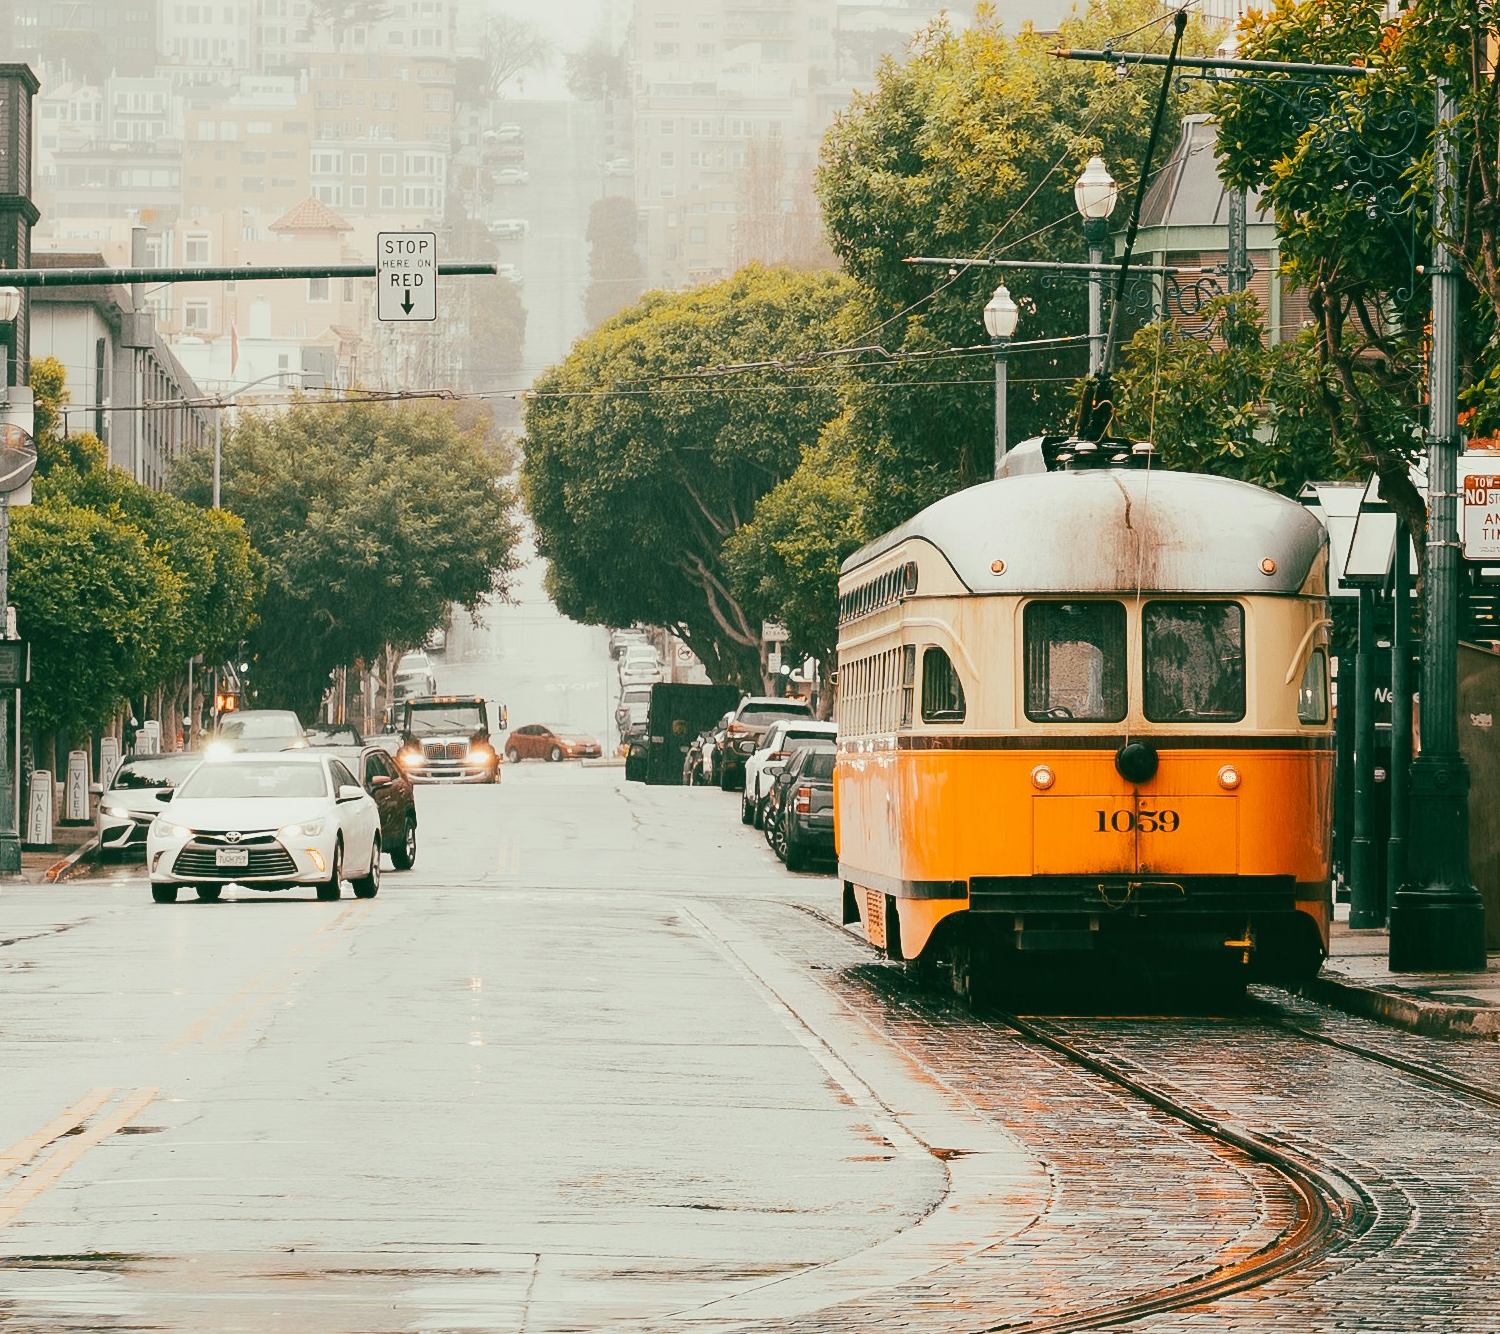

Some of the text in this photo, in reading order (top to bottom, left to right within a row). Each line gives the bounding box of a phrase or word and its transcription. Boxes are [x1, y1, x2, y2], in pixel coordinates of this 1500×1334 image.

[385, 240, 429, 254] STOP
[382, 259, 431, 268] HERE ON
[391, 273, 423, 287] RED
[1465, 488, 1486, 505] NO
[73, 772, 81, 818] VALET
[34, 793, 43, 842] VALET
[1093, 809, 1180, 833] 1059
